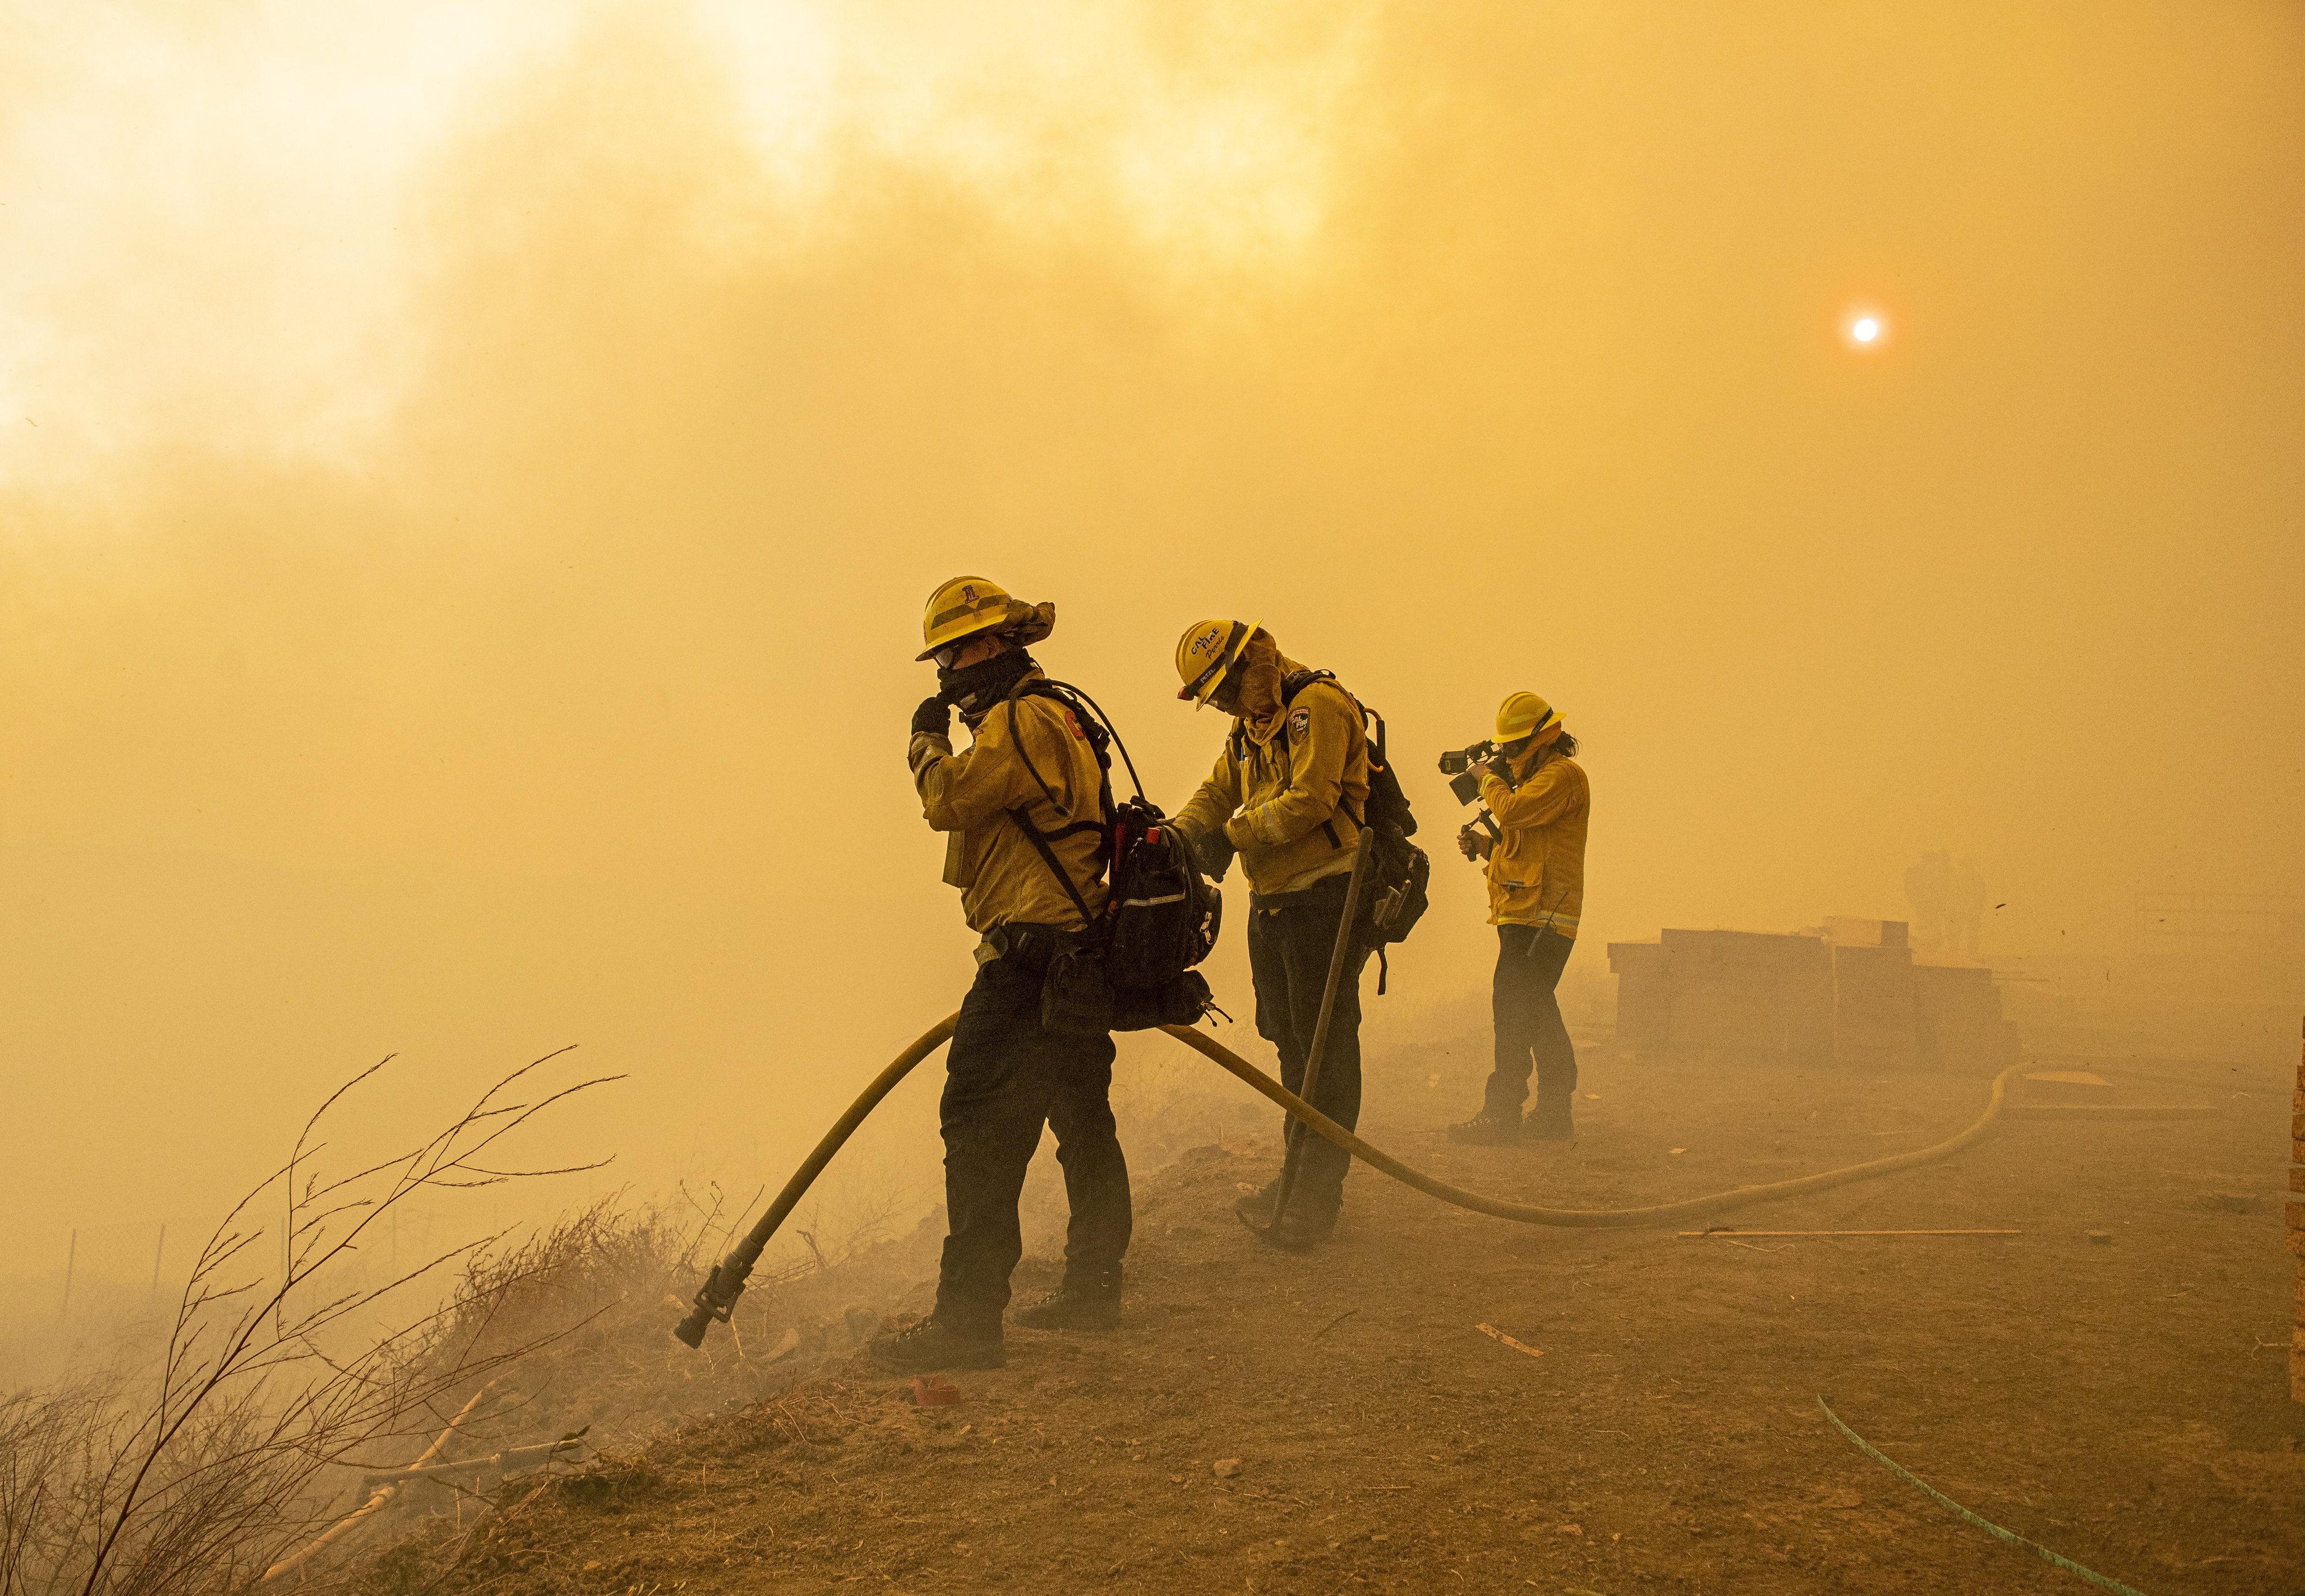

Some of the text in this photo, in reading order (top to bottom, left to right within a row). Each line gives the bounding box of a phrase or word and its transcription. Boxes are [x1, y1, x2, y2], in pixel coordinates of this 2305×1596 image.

[1191, 636, 1205, 655] CAL
[1201, 627, 1220, 650] FIRE
[1206, 636, 1225, 660] Perris
